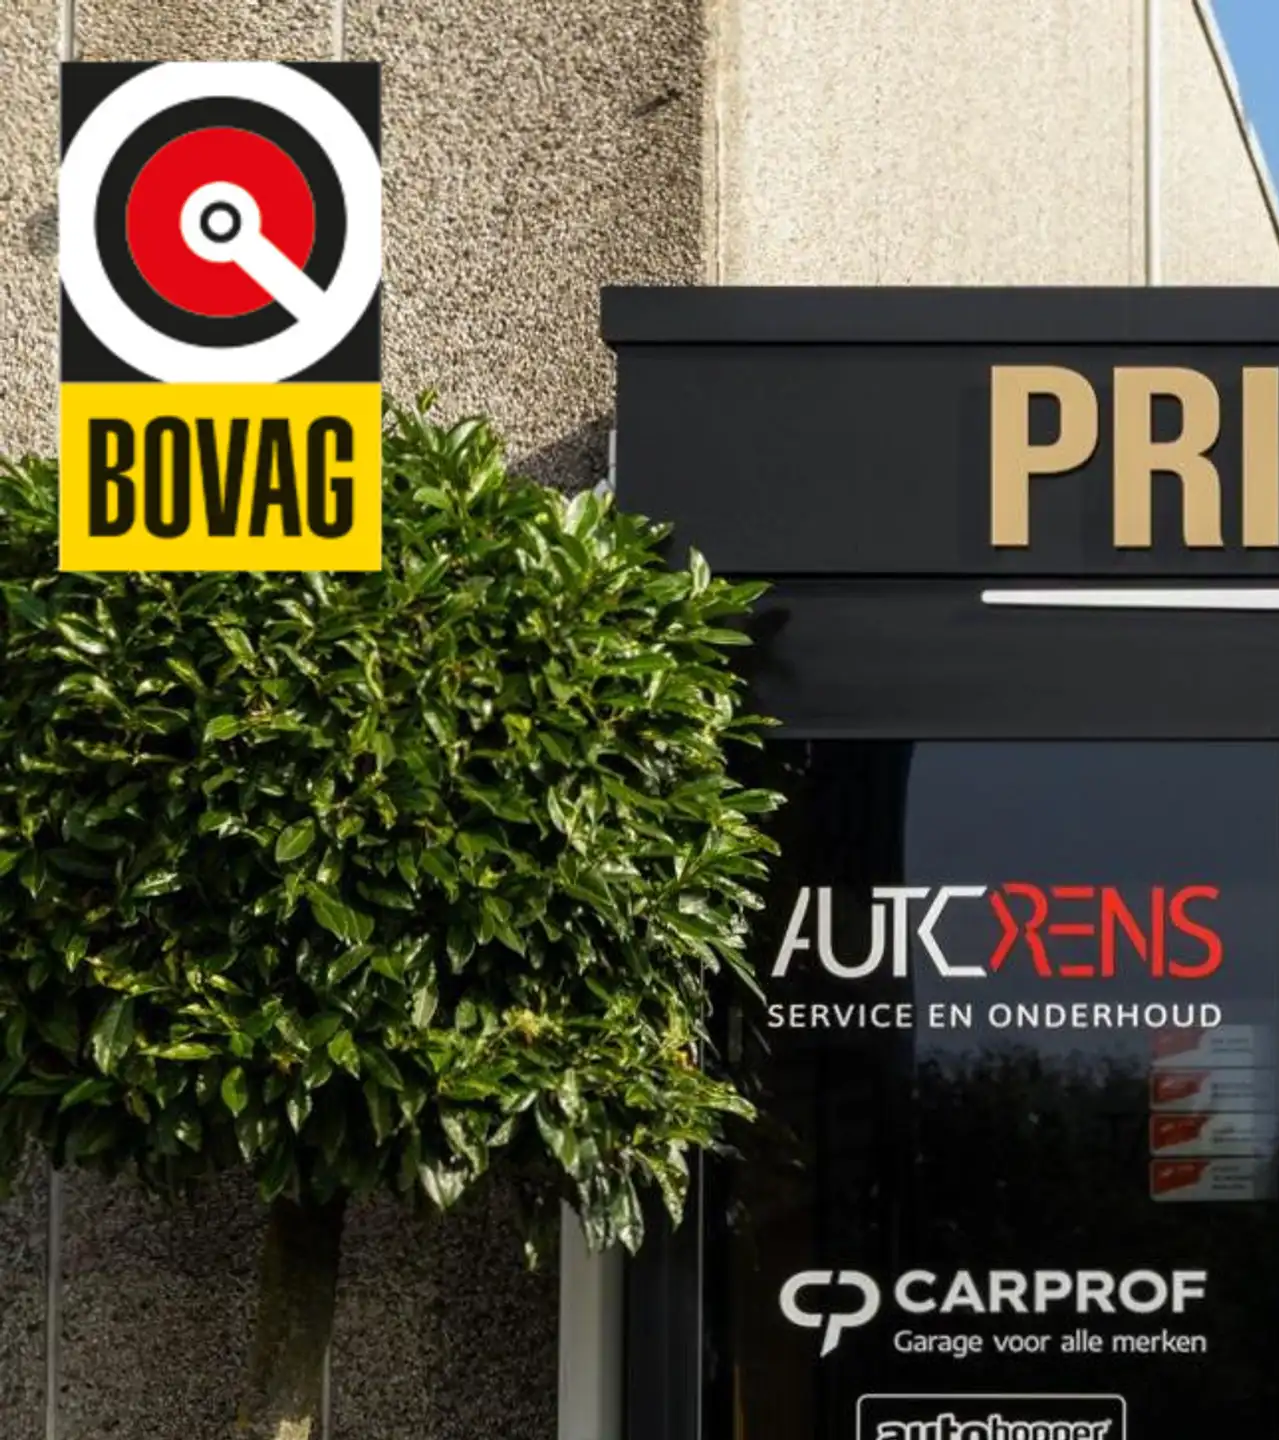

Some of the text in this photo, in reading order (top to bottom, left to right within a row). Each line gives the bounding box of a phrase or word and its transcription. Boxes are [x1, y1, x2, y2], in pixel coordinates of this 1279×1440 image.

[768, 1003, 1222, 1028] SERVICE EN ONDERHOUD
[894, 1269, 1207, 1313] CARPROF
[893, 1328, 1207, 1359] Garage voor alle merken
